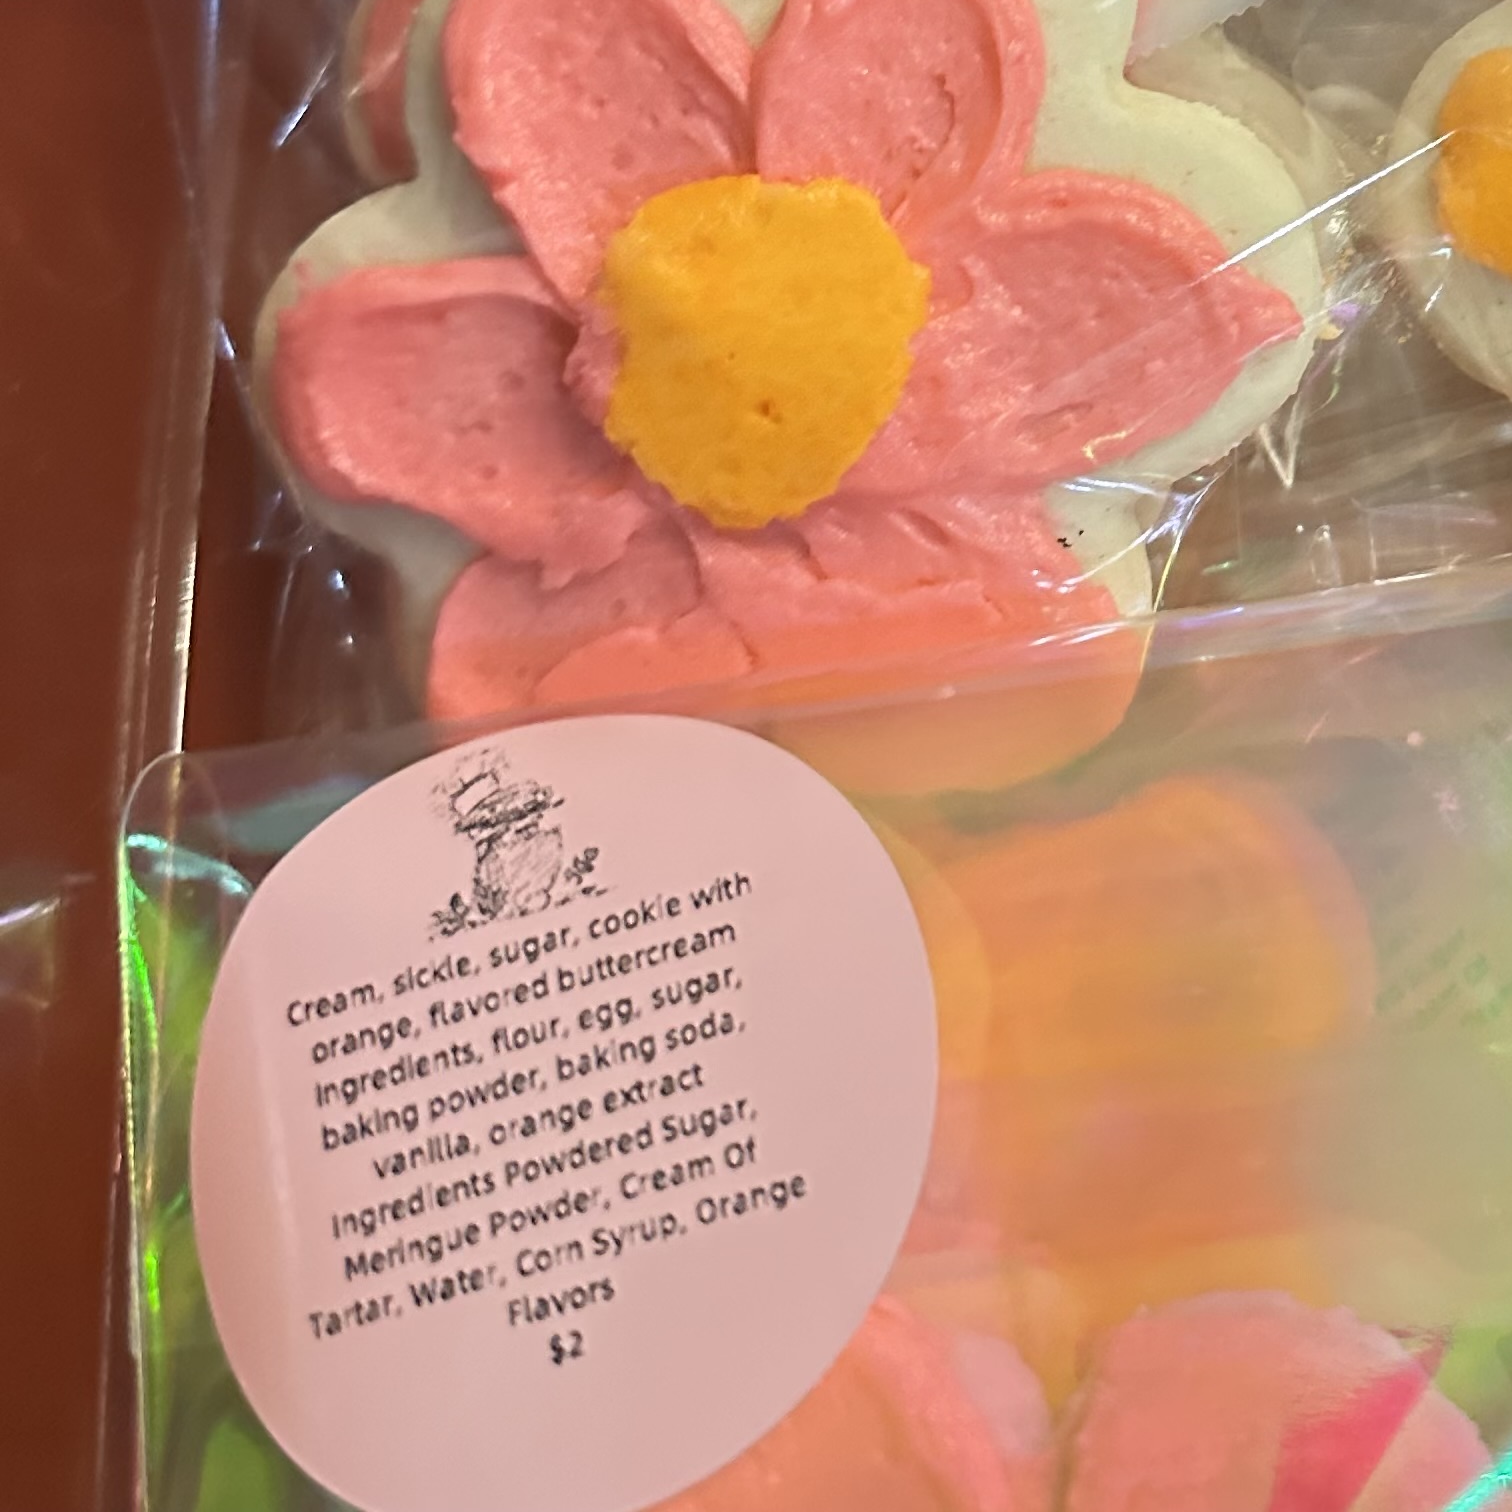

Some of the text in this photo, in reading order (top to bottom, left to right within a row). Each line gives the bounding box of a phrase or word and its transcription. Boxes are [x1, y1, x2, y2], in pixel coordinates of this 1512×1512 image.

[286, 872, 752, 1028] Cream, sickle, sugar, cookie with
[312, 923, 737, 1065] orange, flavored buttercream
[490, 1017, 571, 1056] flour,
[577, 997, 642, 1033] egg,
[651, 967, 743, 1012] sugar,
[321, 1011, 746, 1152] baking powder, baking soda,
[372, 1063, 705, 1181] vanilla, orange extract
[332, 1099, 757, 1240] Ingredients Powdered Sugar,
[344, 1135, 757, 1283] Meringue Powder, Cream Of
[308, 1175, 807, 1340] Tartar, Water, Corn Syrup, Orange
[508, 1277, 616, 1327] Flavors
[549, 1330, 584, 1367] $2
